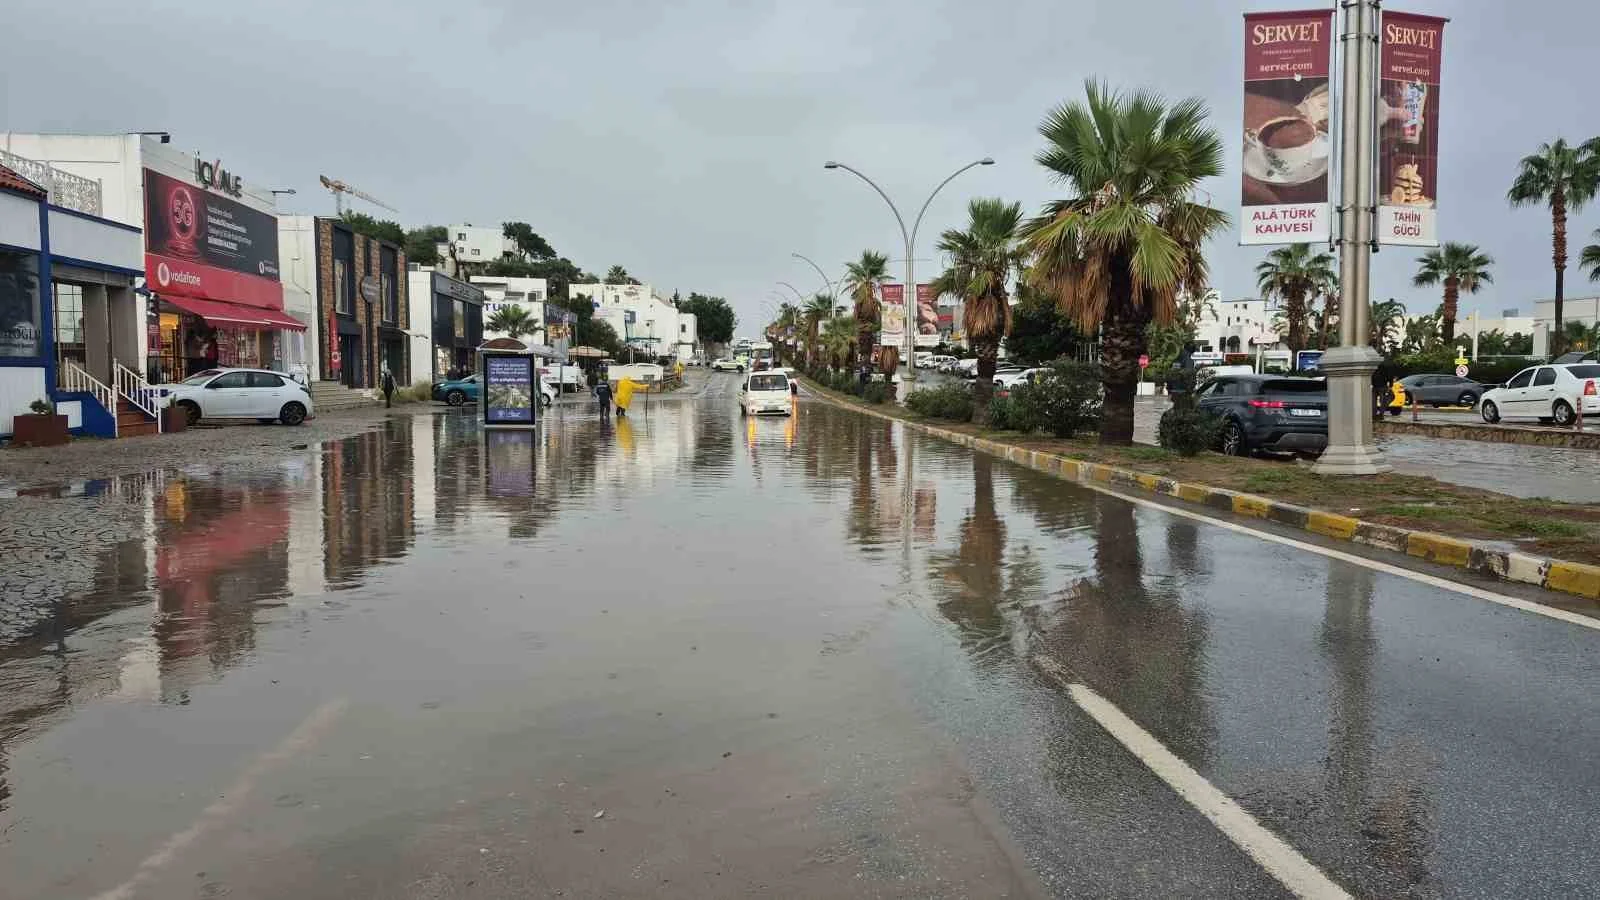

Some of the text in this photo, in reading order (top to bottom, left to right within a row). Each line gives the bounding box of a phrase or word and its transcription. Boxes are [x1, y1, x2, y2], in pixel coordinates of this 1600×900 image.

[1252, 21, 1322, 45] SERVET
[1386, 24, 1436, 49] SERVET
[1259, 62, 1313, 72] servet.com
[1391, 65, 1430, 76] servet.com
[174, 200, 192, 227] 5G
[1281, 207, 1316, 220] TÜRK
[1393, 210, 1421, 223] TAHİN
[1255, 220, 1313, 234] KAHVESİ
[1393, 224, 1420, 236] GÜCÜ
[170, 271, 201, 286] vodafone
